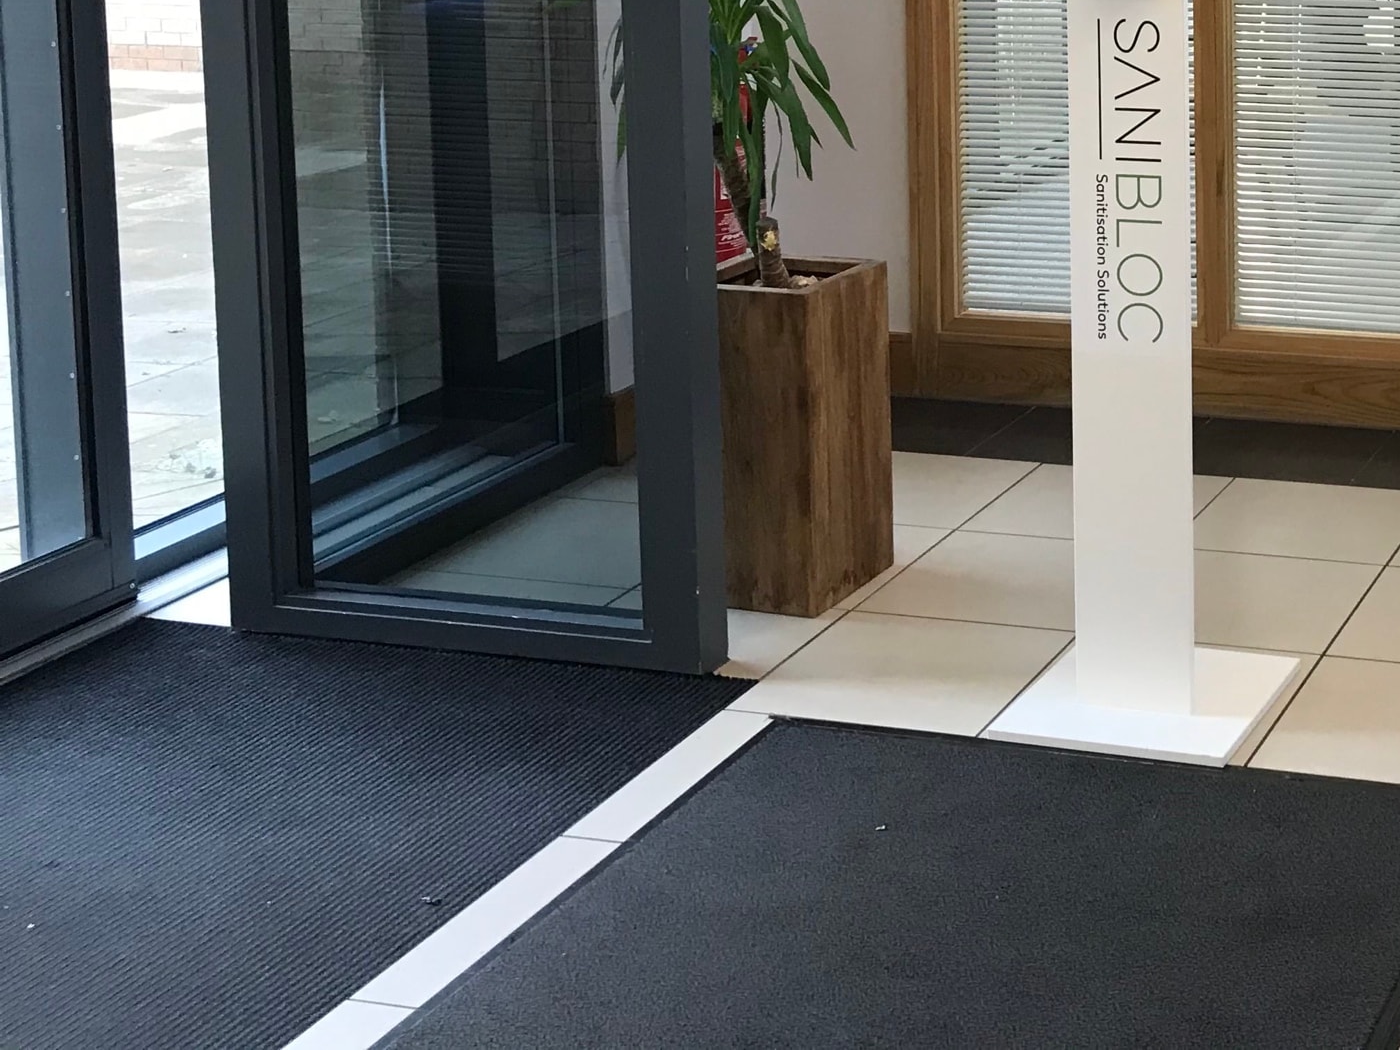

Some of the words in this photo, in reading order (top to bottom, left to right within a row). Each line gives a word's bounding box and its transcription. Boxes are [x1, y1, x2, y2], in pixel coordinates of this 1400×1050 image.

[1096, 174, 1109, 265] Sanitisation
[1113, 18, 1164, 343] SANIBLOC
[1097, 270, 1110, 340] Solutions
